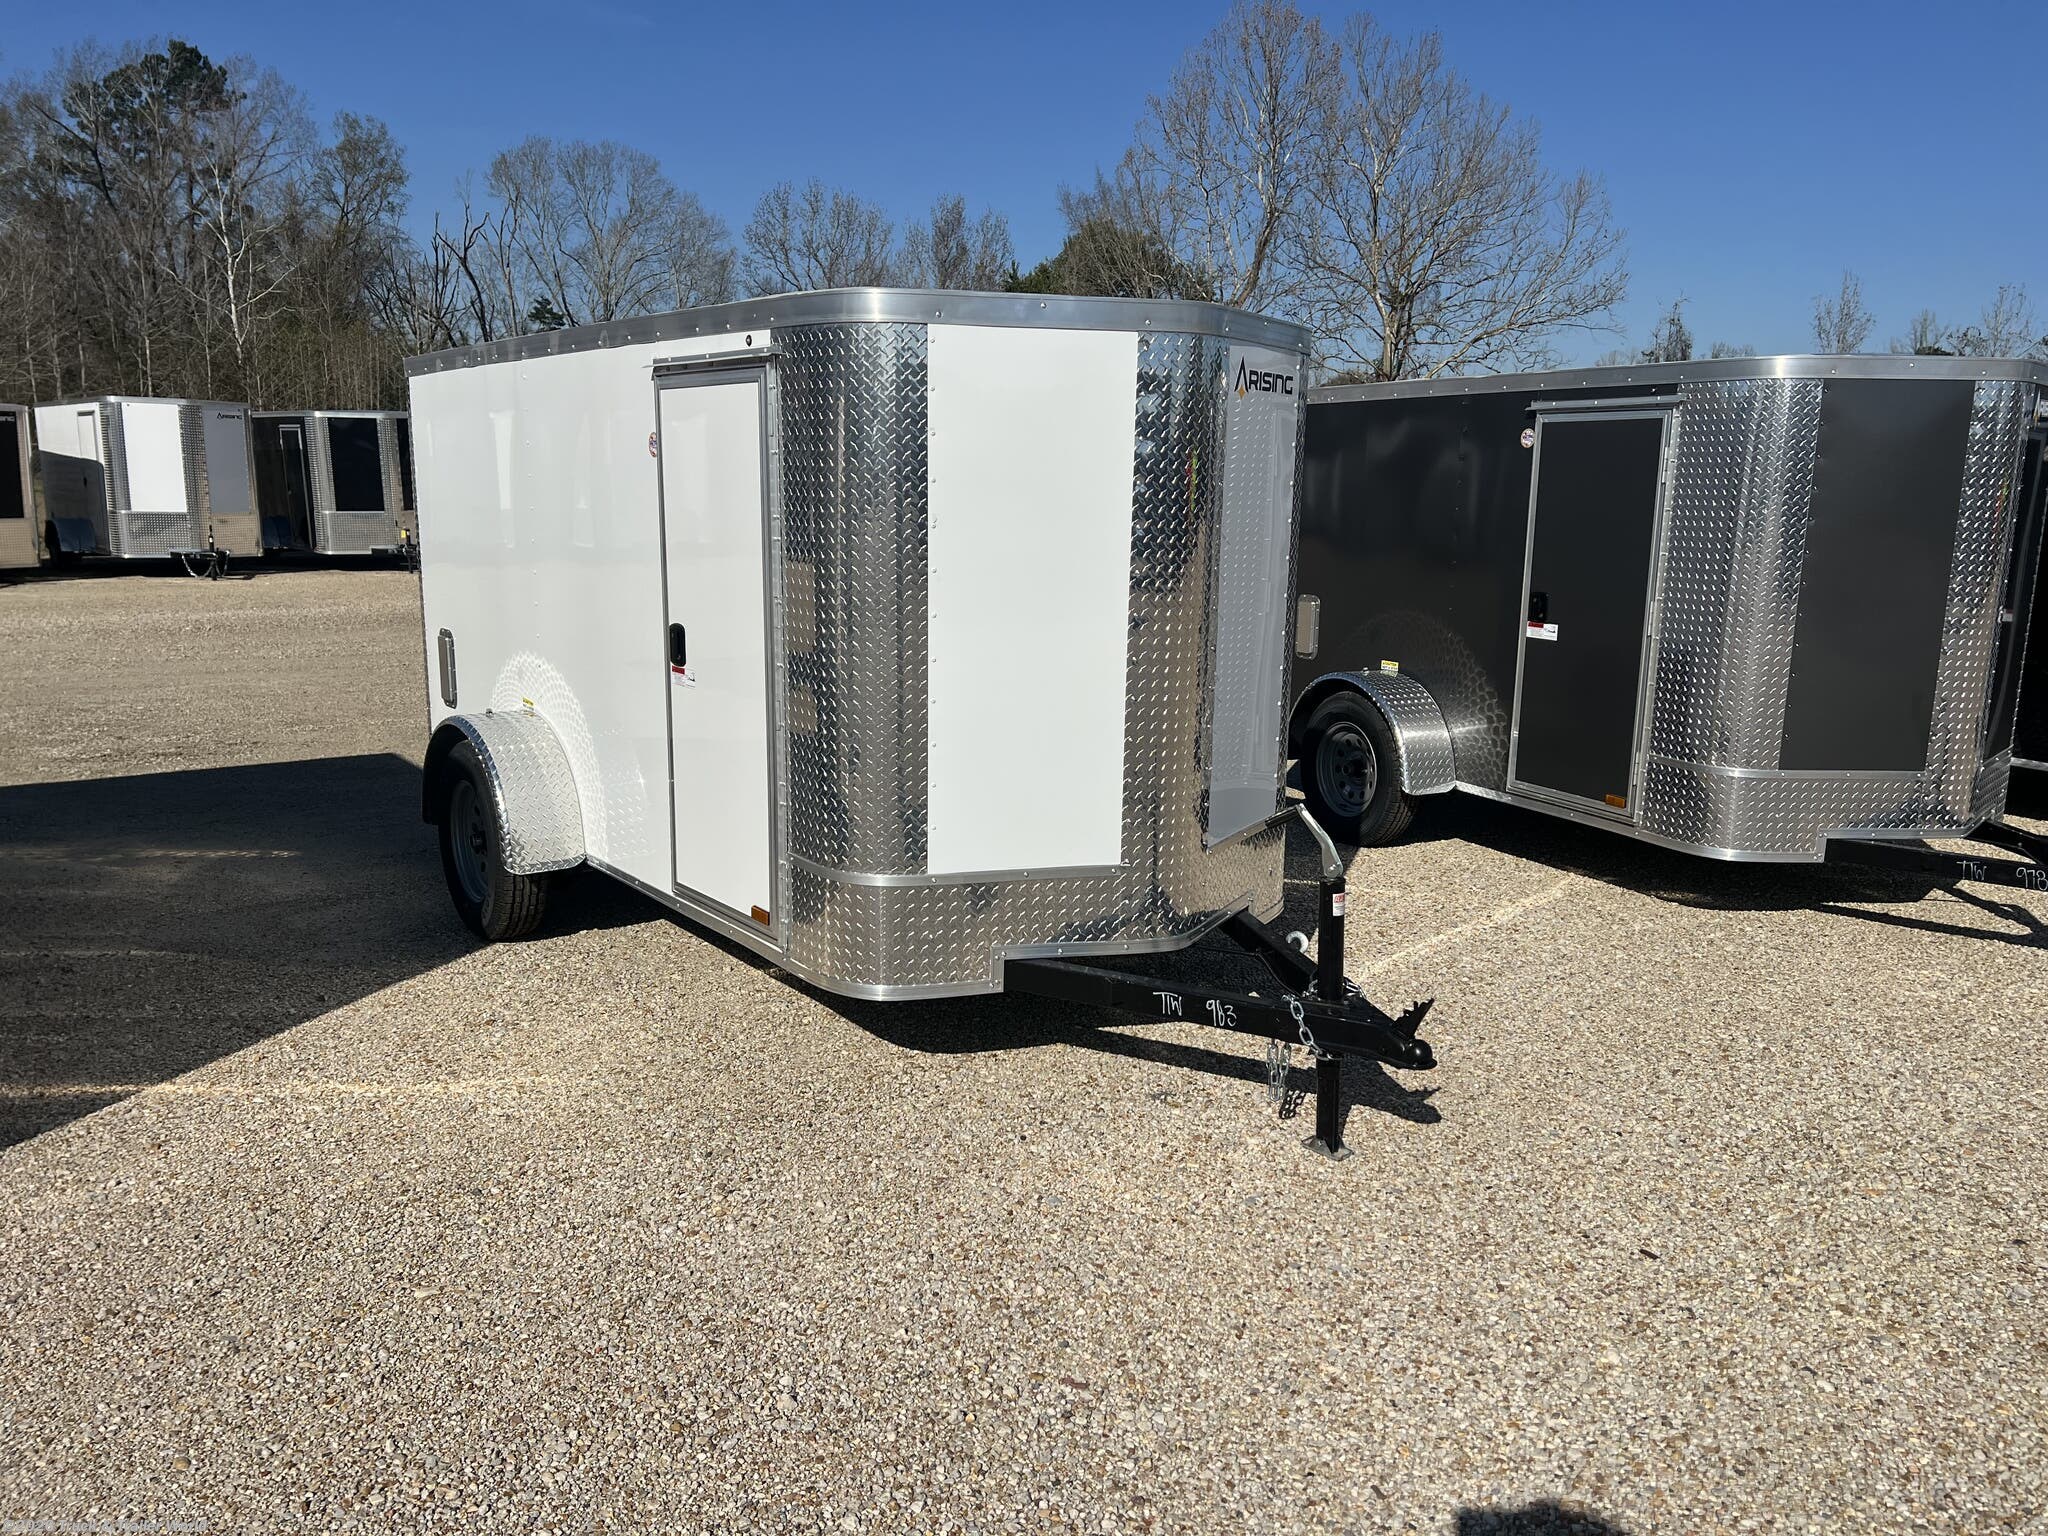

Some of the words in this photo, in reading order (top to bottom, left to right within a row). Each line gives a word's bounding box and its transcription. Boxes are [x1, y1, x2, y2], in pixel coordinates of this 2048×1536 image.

[1234, 355, 1294, 395] ARISING
[2016, 866, 2048, 892] 978
[1205, 999, 1238, 1027] 983
